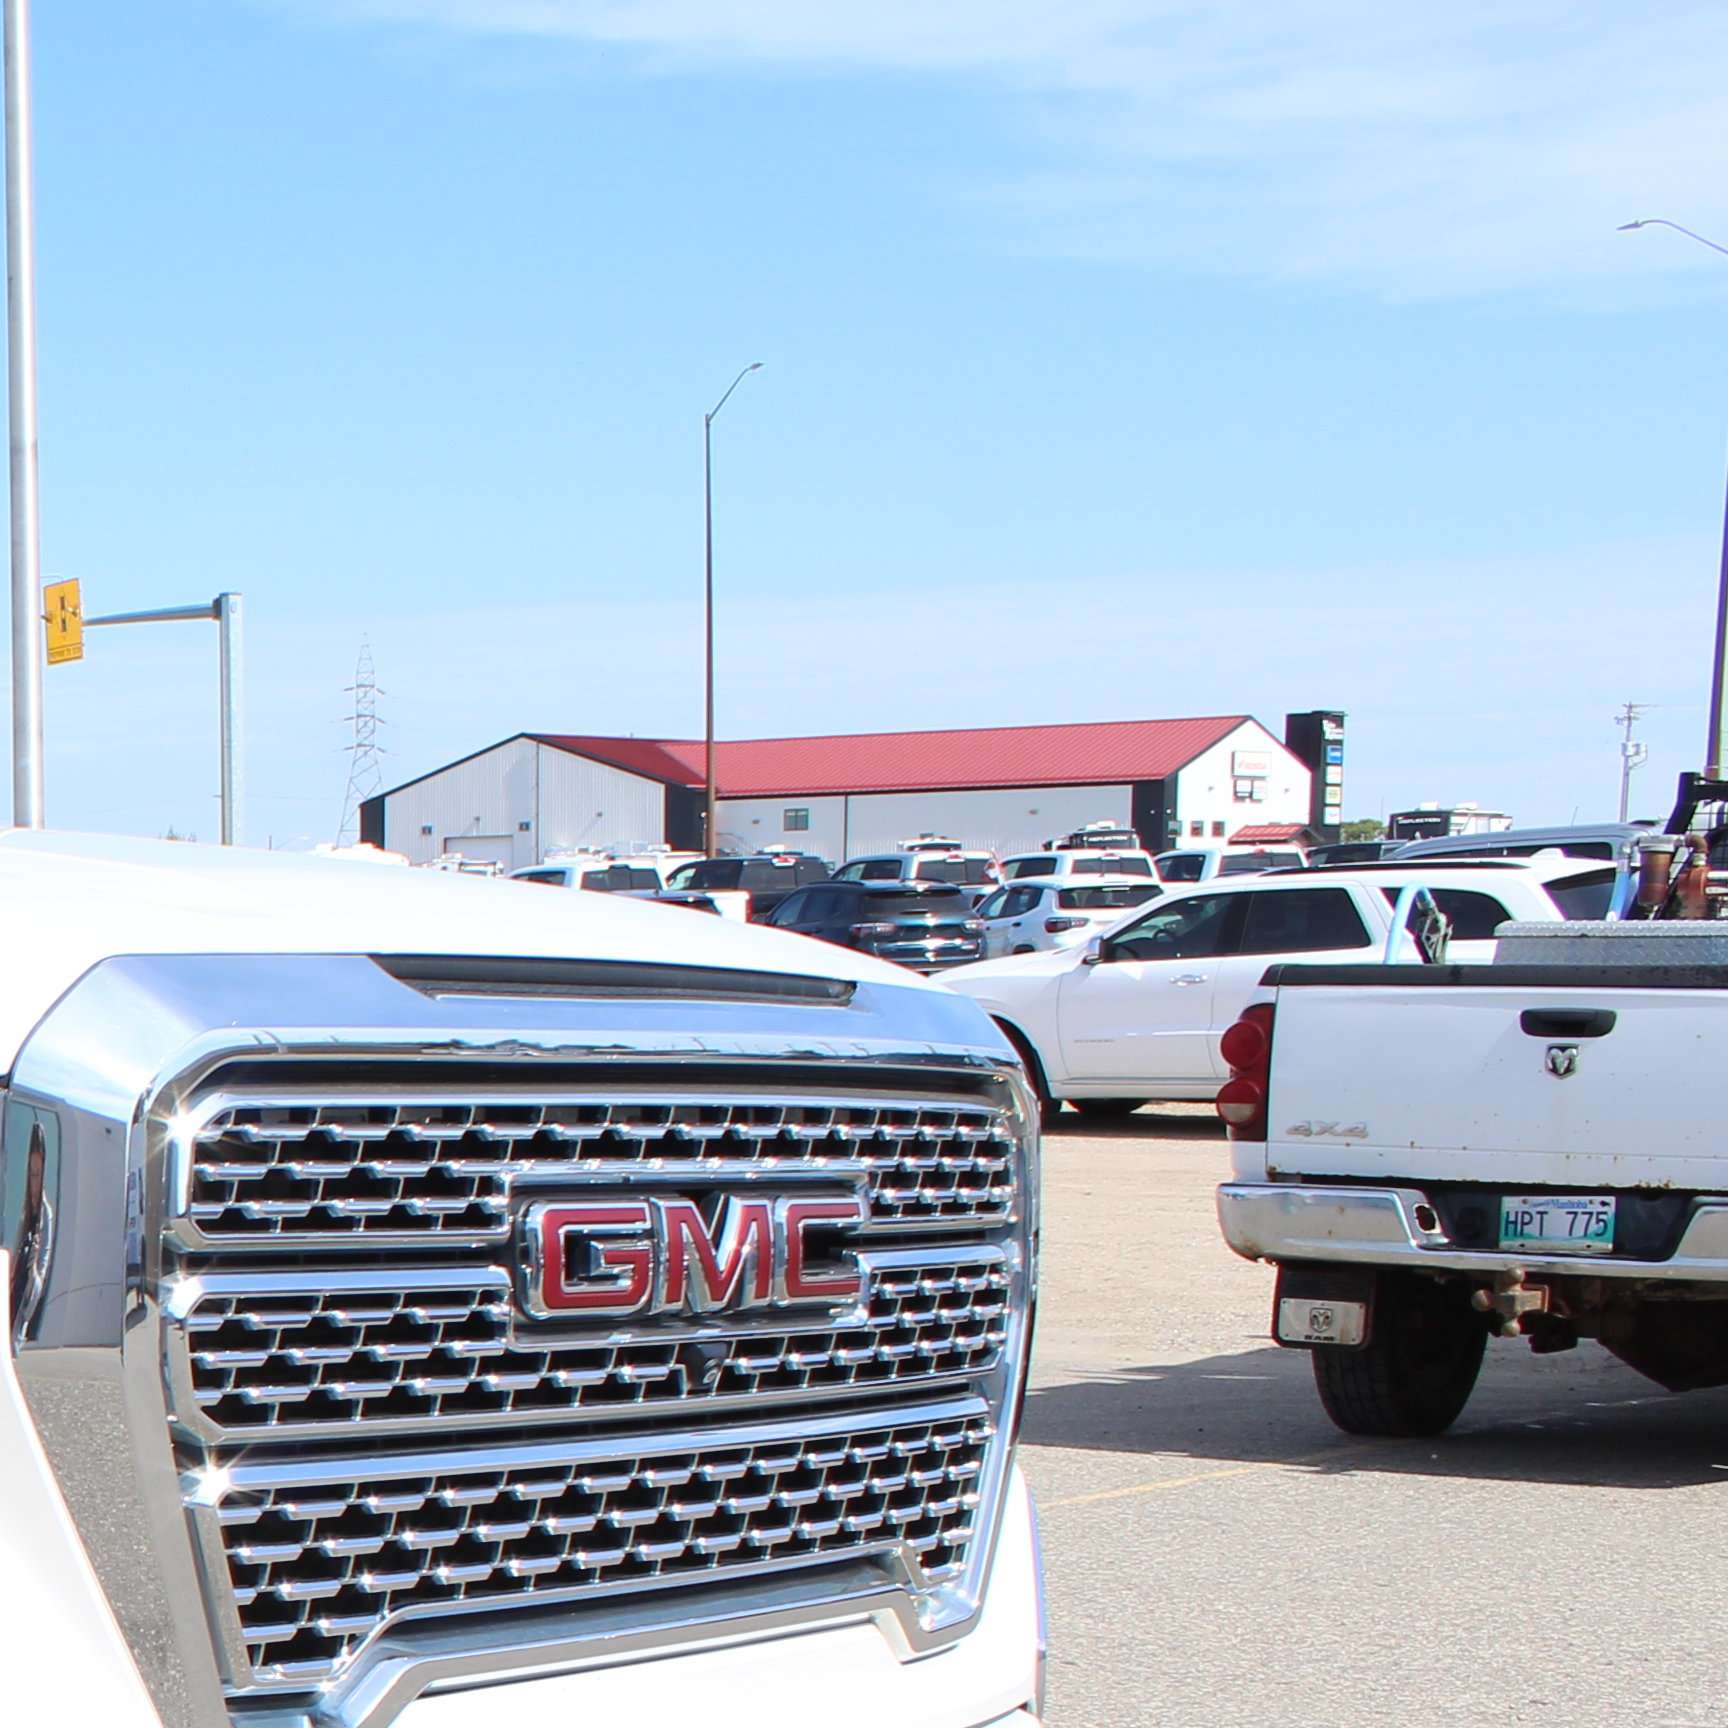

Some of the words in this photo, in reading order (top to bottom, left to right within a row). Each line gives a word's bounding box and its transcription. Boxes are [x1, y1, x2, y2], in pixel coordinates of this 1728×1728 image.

[520, 1196, 868, 1319] GMC
[1505, 1211, 1549, 1237] HPT
[1565, 1211, 1609, 1237] 775
